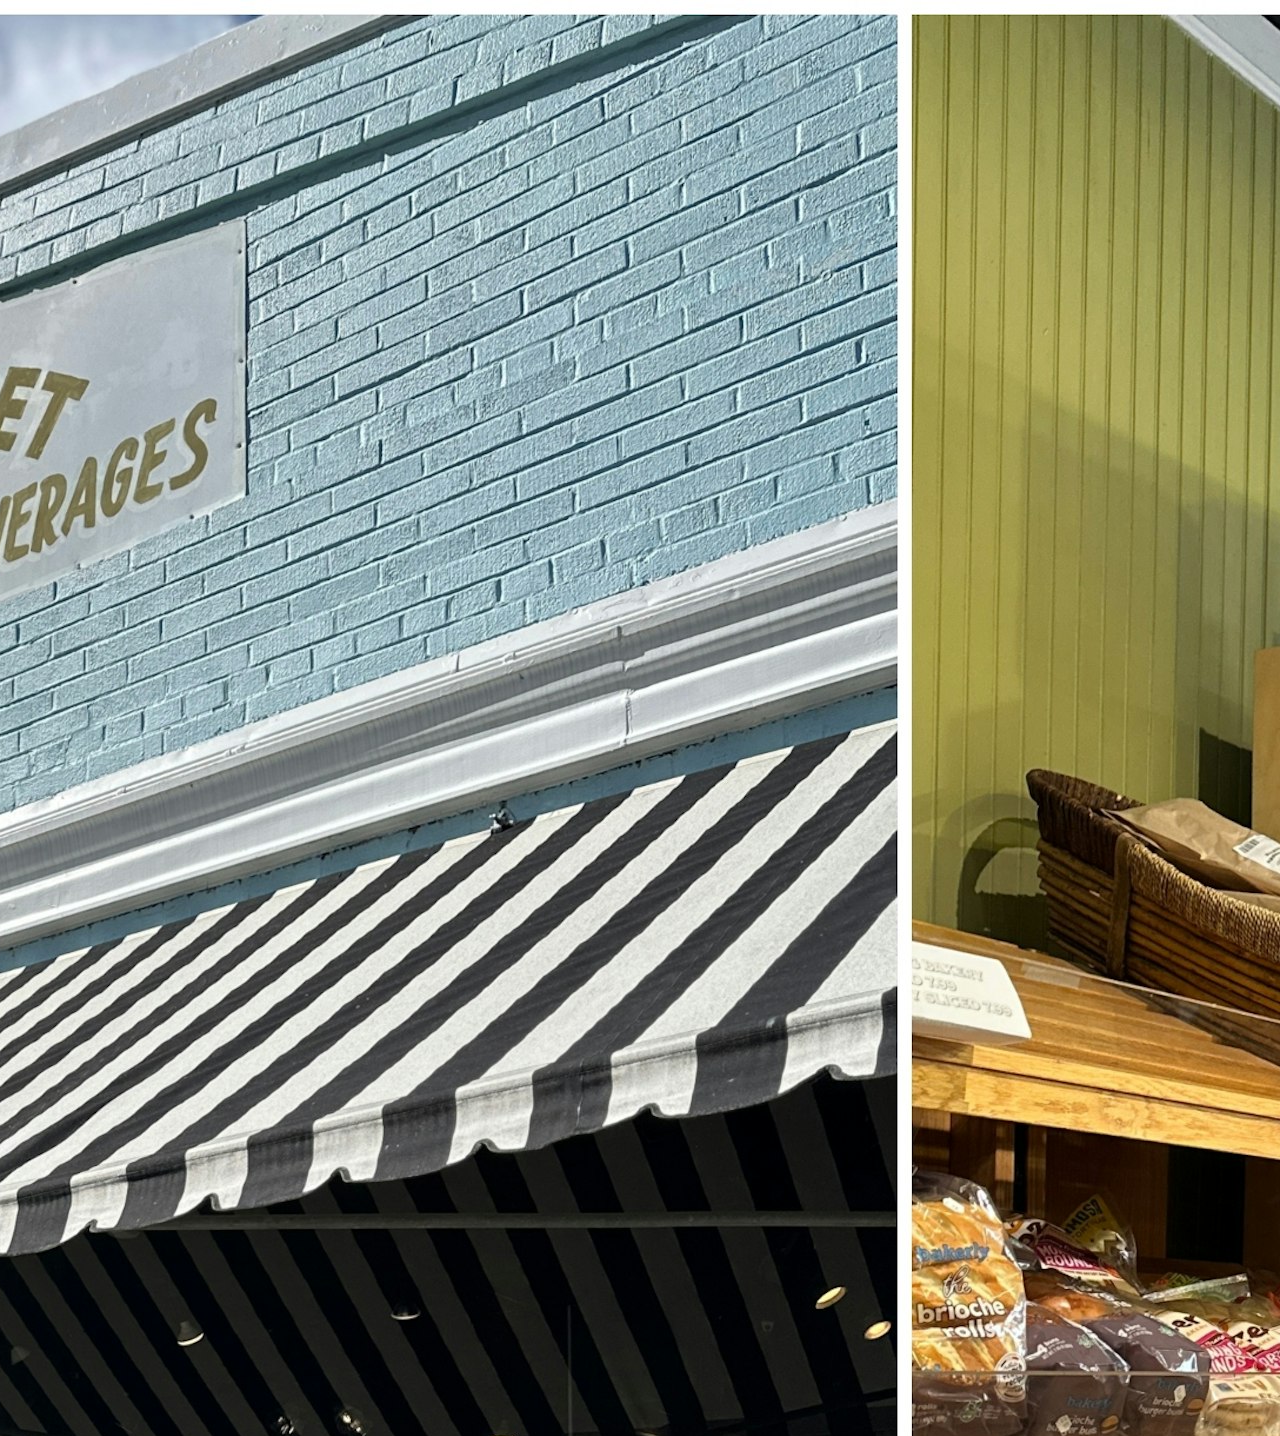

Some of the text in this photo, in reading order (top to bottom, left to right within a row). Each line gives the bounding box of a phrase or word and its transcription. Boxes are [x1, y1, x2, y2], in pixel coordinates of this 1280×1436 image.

[942, 1266, 972, 1297] the
[917, 1300, 1006, 1325] brioche
[942, 1321, 1002, 1339] rolls
